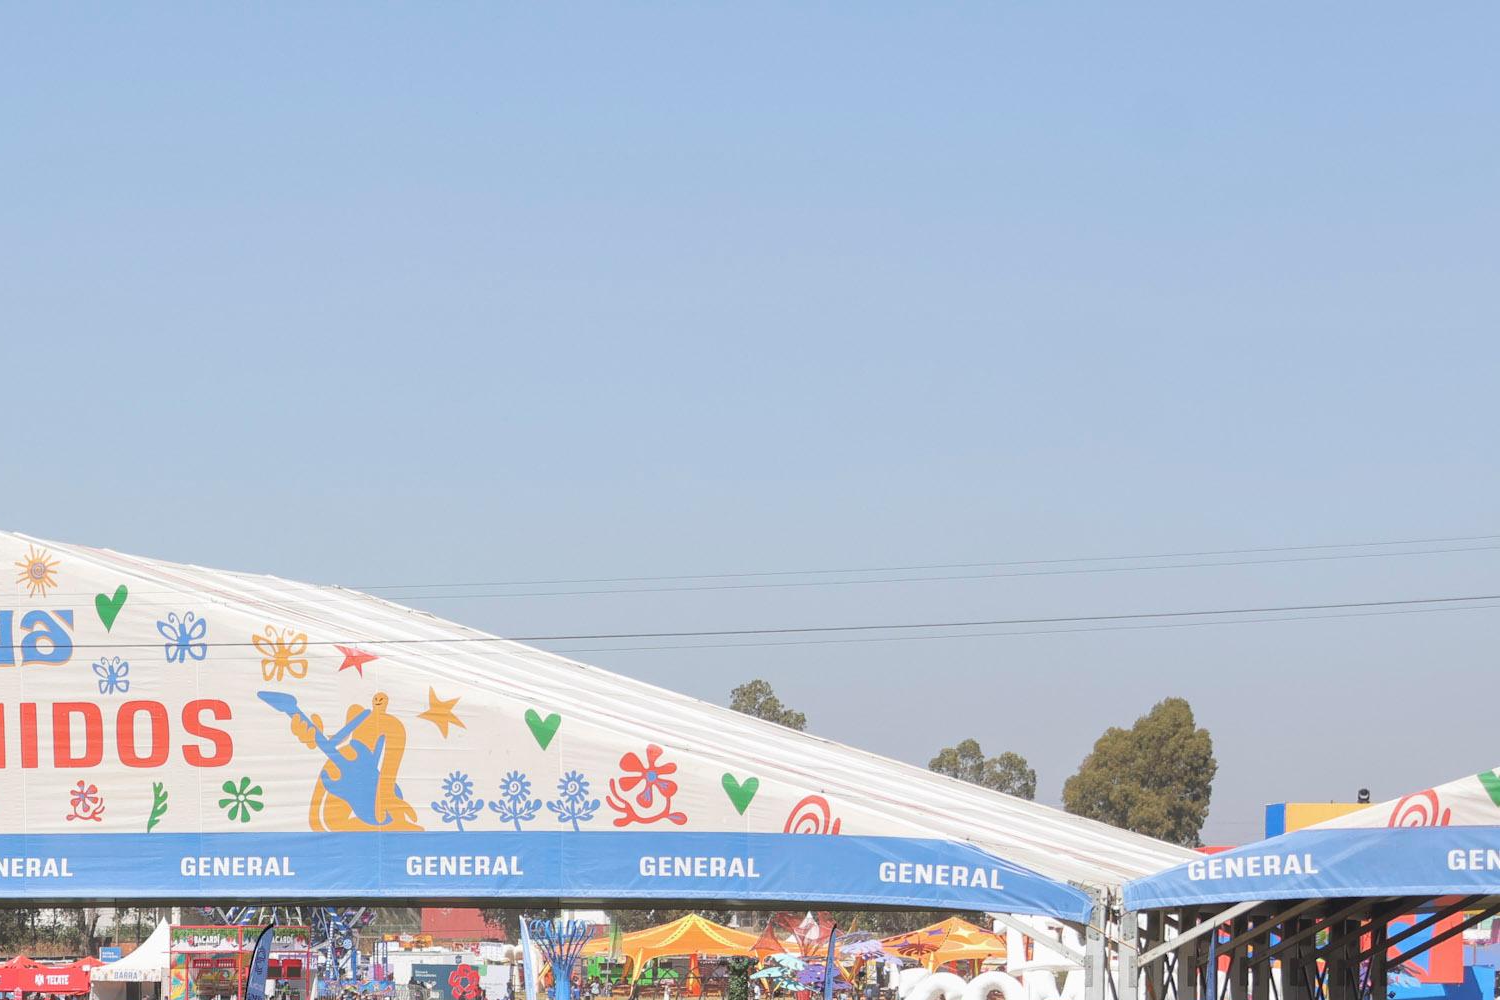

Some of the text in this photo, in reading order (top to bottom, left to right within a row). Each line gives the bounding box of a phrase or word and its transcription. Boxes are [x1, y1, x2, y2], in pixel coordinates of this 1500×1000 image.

[180, 856, 295, 877] GENERAL
[406, 855, 523, 876] GENERAL
[639, 856, 760, 878] GENERAL
[879, 862, 1004, 890] GENERAL
[1188, 854, 1319, 881] GENERAL
